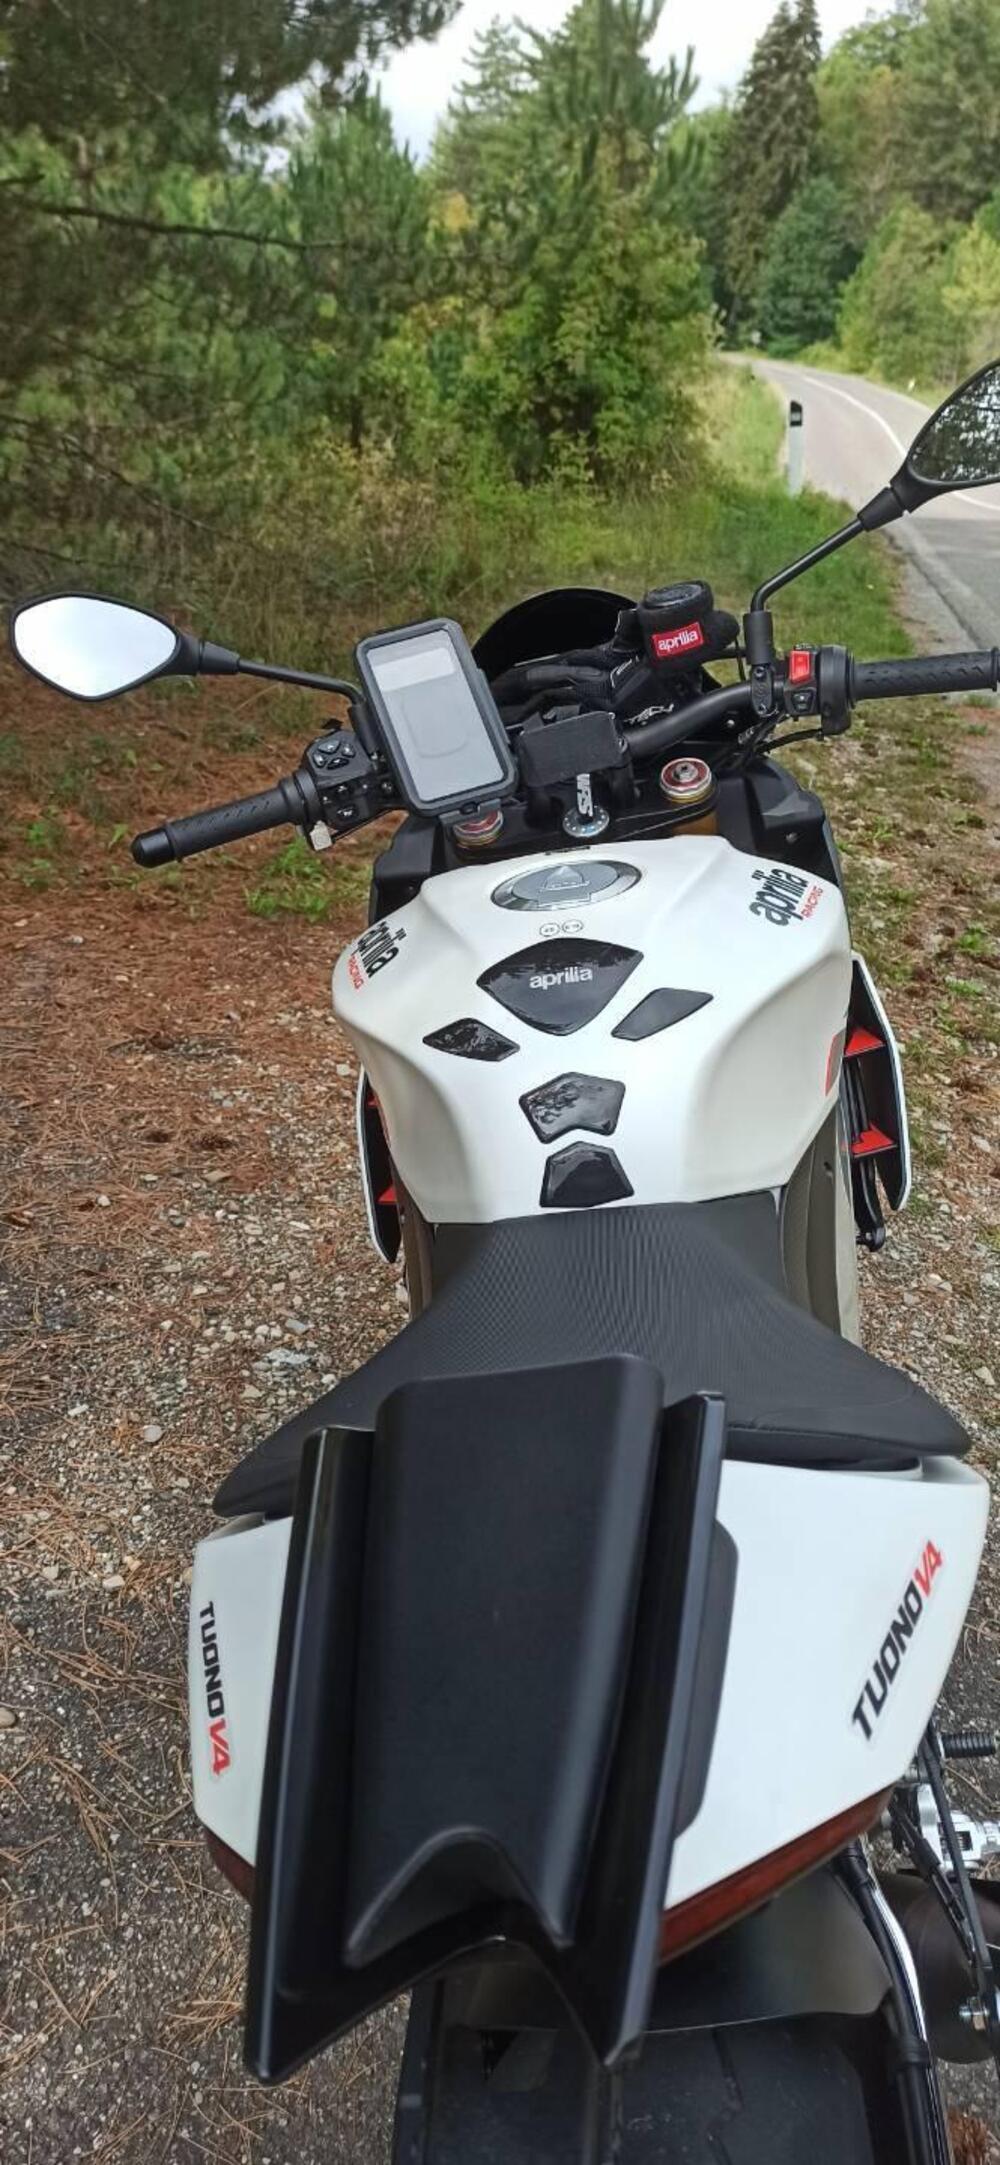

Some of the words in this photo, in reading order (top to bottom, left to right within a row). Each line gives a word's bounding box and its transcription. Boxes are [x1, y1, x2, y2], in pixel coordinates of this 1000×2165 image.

[658, 629, 698, 652] aprilia
[749, 868, 809, 926] aprilia
[801, 885, 823, 918] RACING
[351, 921, 407, 978] aprilia
[528, 965, 594, 990] aprilia
